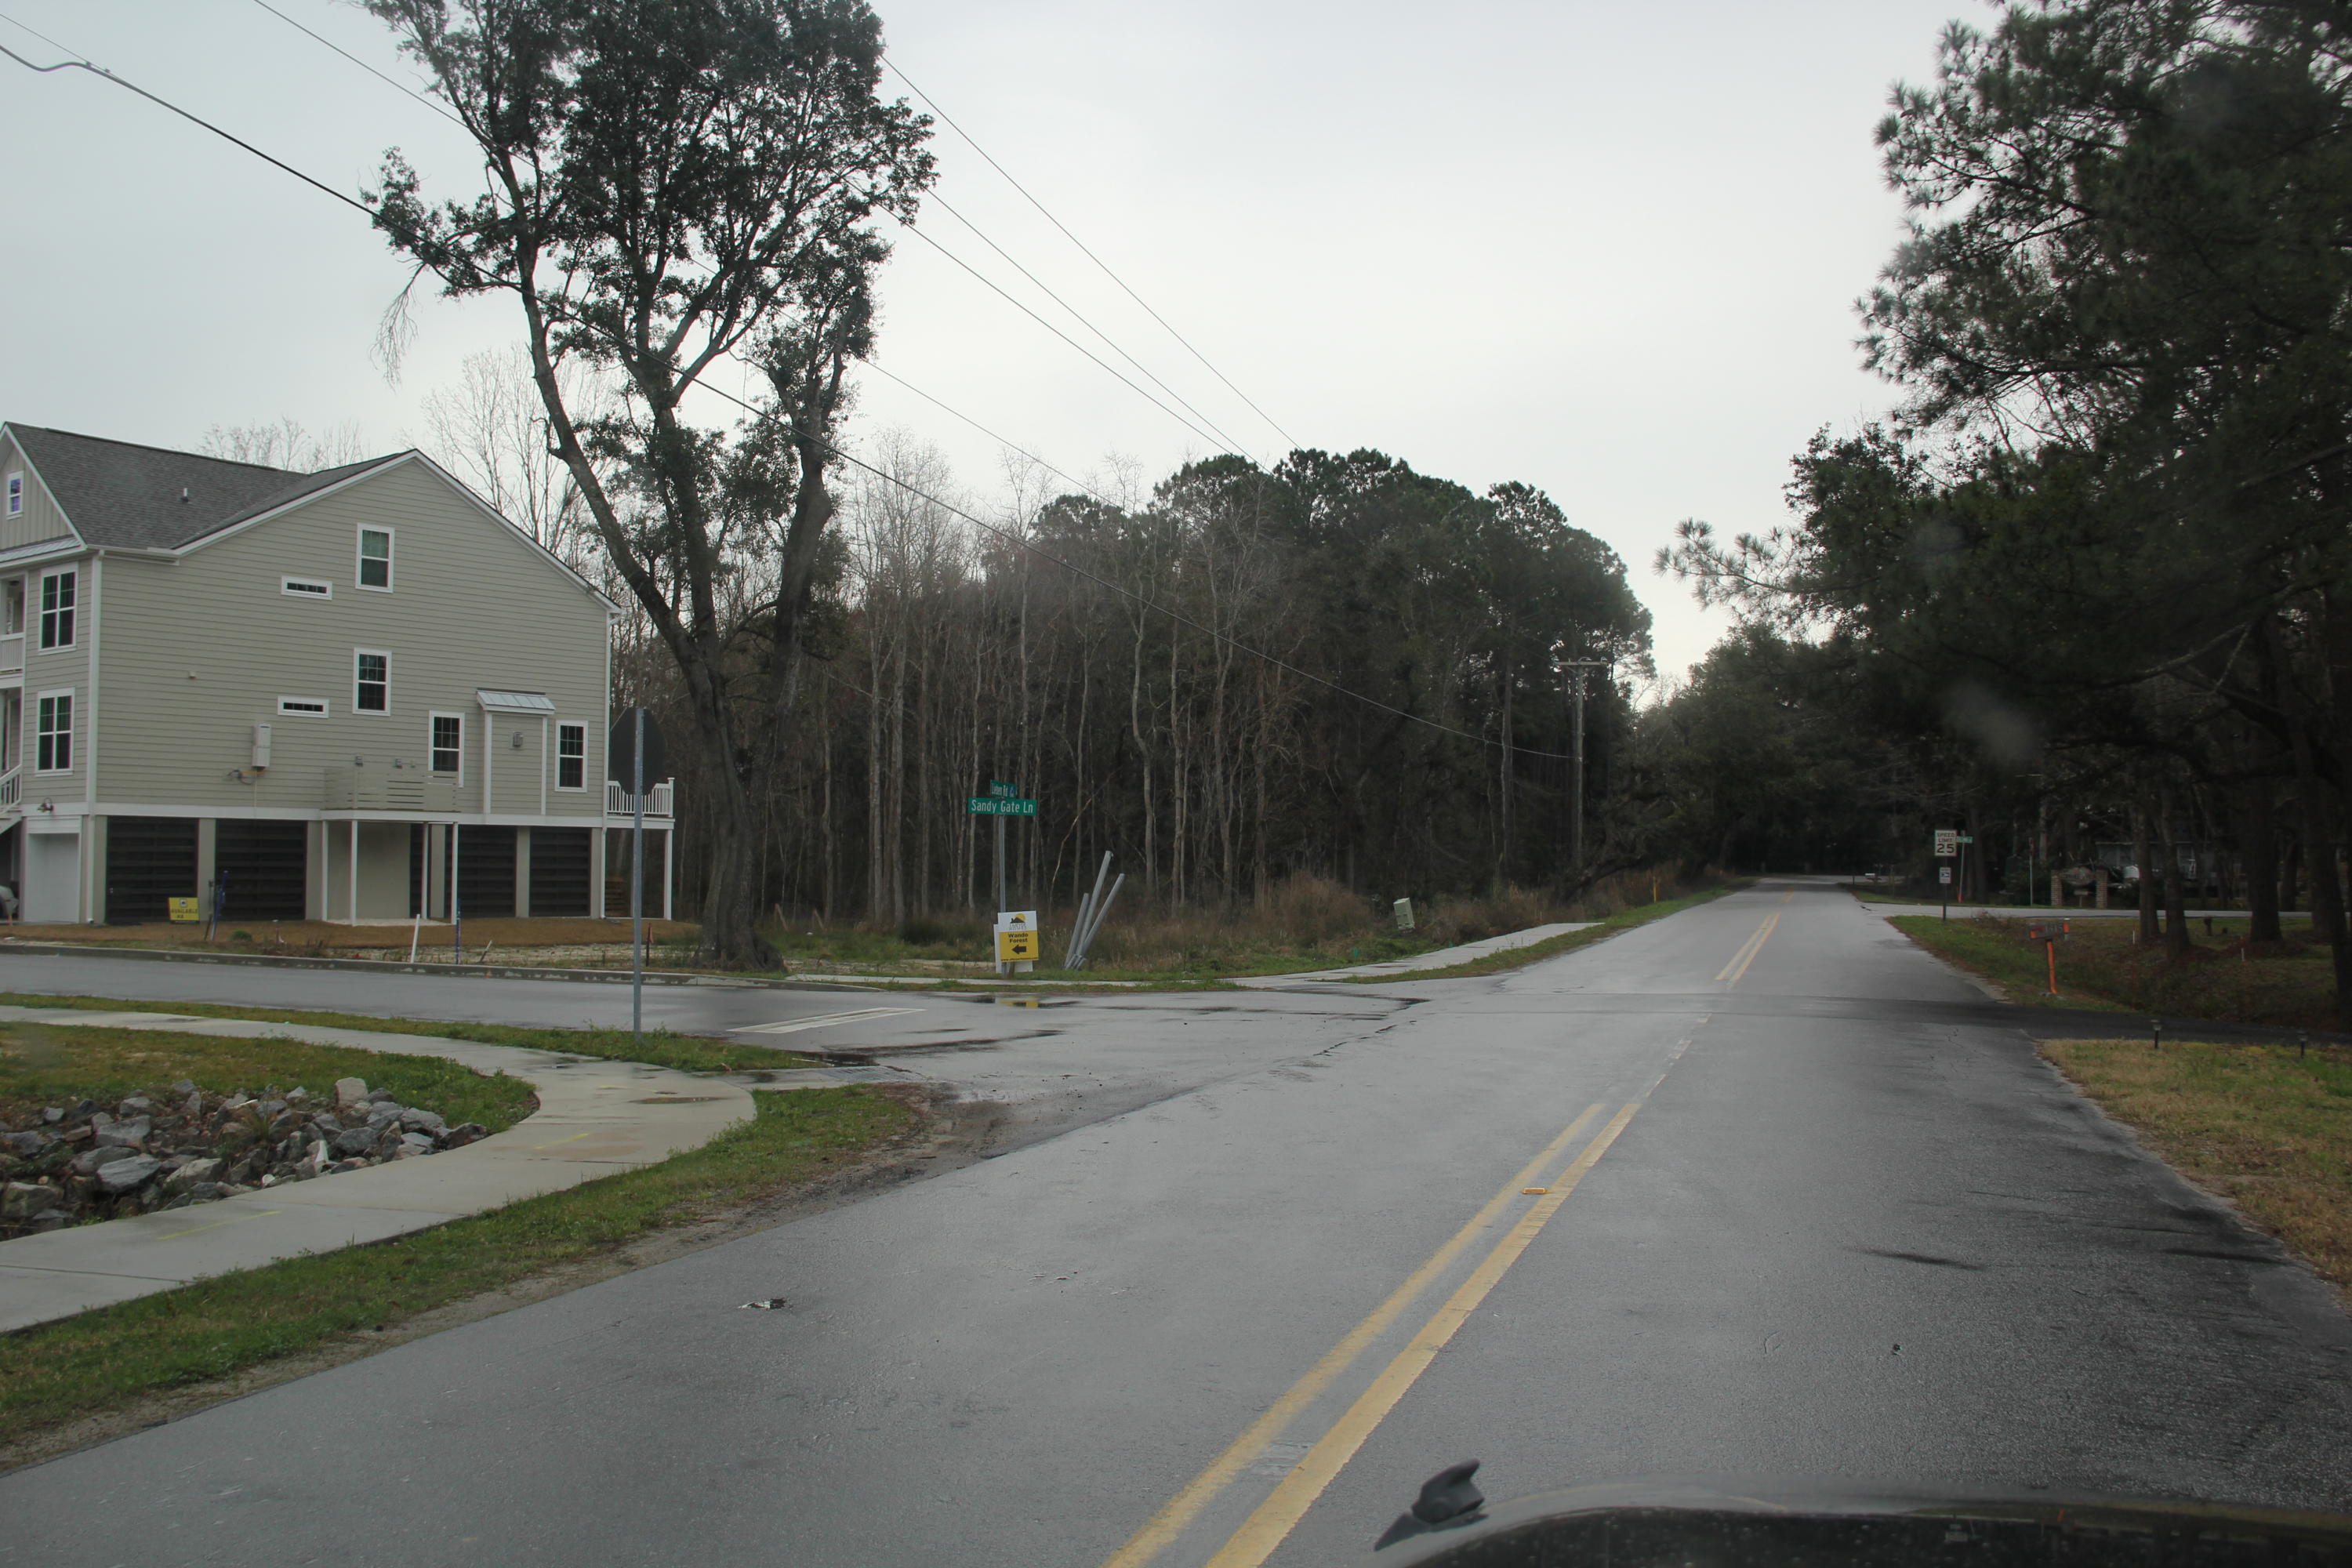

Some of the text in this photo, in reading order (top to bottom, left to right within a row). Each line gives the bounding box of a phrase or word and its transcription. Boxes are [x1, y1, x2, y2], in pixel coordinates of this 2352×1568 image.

[1004, 785, 1008, 797] Rd
[971, 799, 1033, 814] Sandy Gate Ln
[1936, 844, 1955, 853] 25
